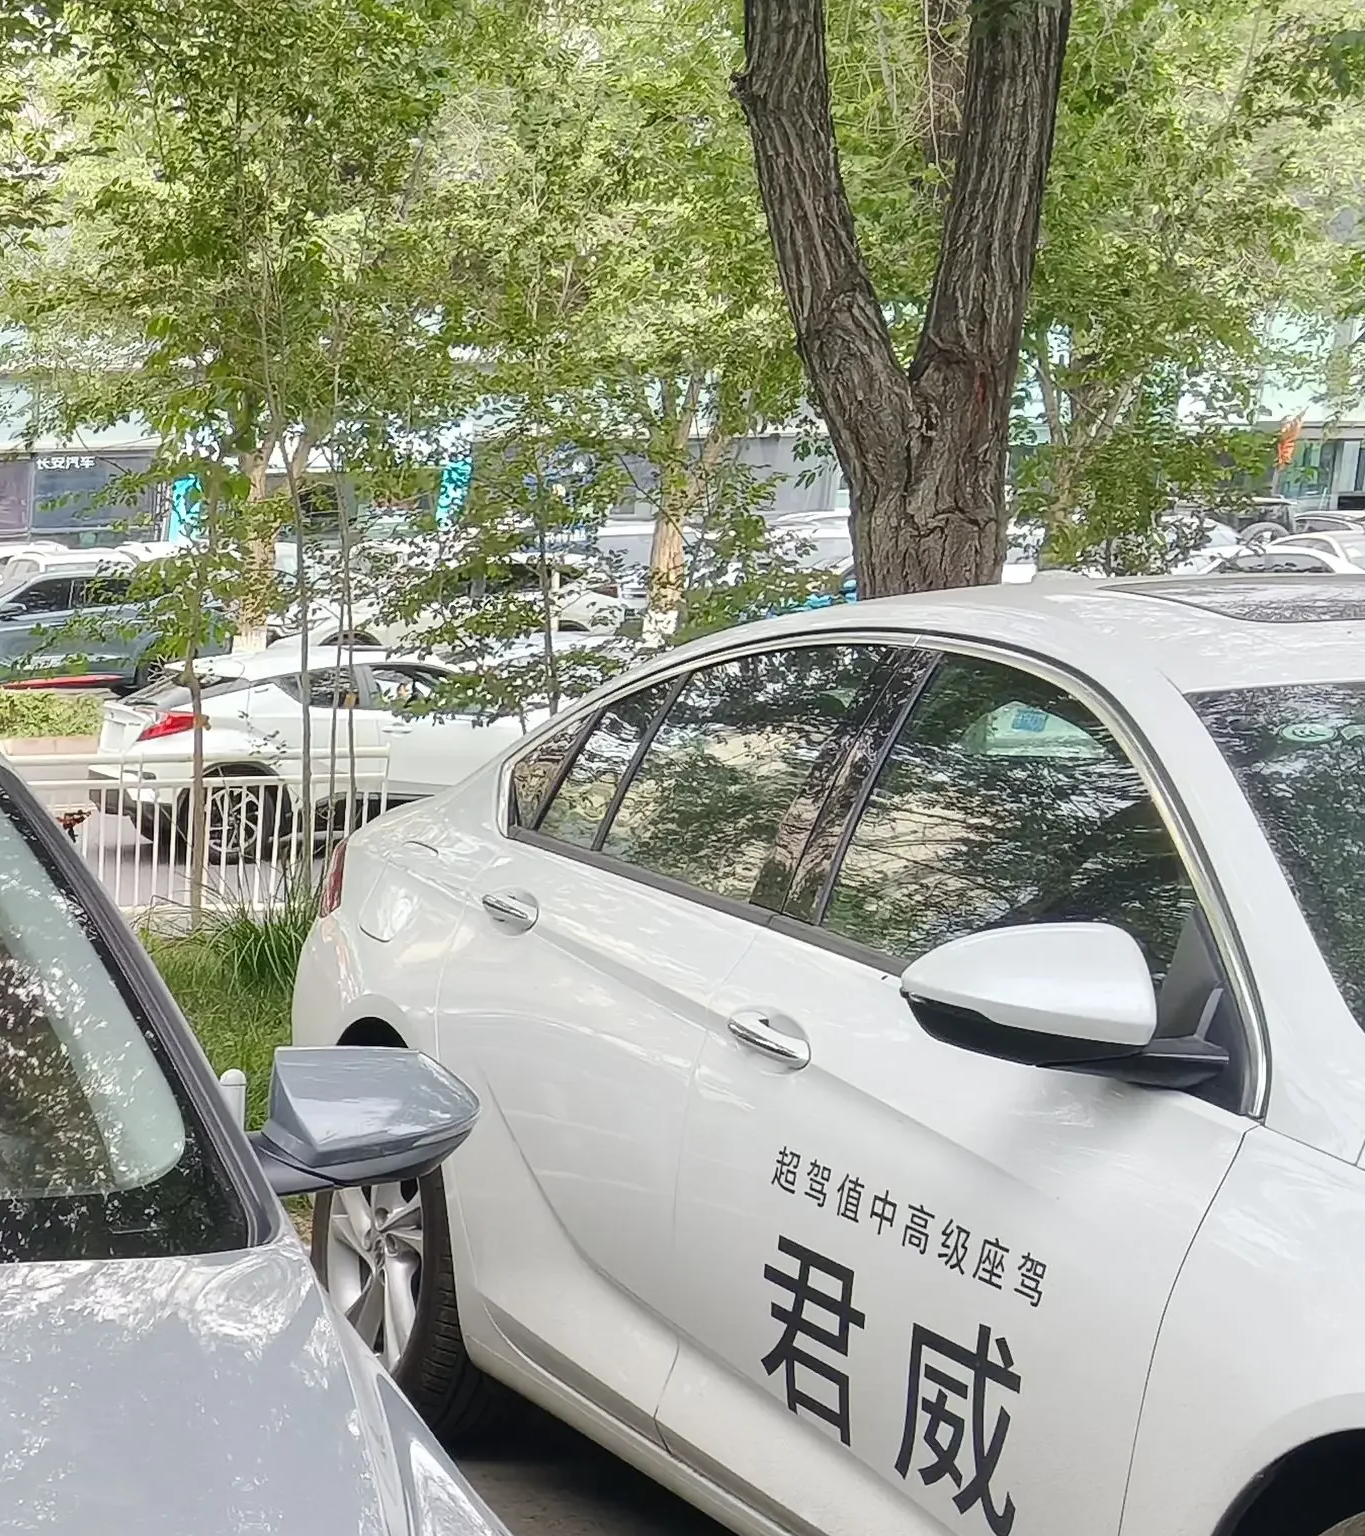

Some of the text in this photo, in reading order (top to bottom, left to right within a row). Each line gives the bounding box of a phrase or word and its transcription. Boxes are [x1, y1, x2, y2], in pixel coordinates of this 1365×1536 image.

[36, 456, 96, 470] 长安汽车
[771, 1146, 1048, 1307] 超驾值中高级座驾
